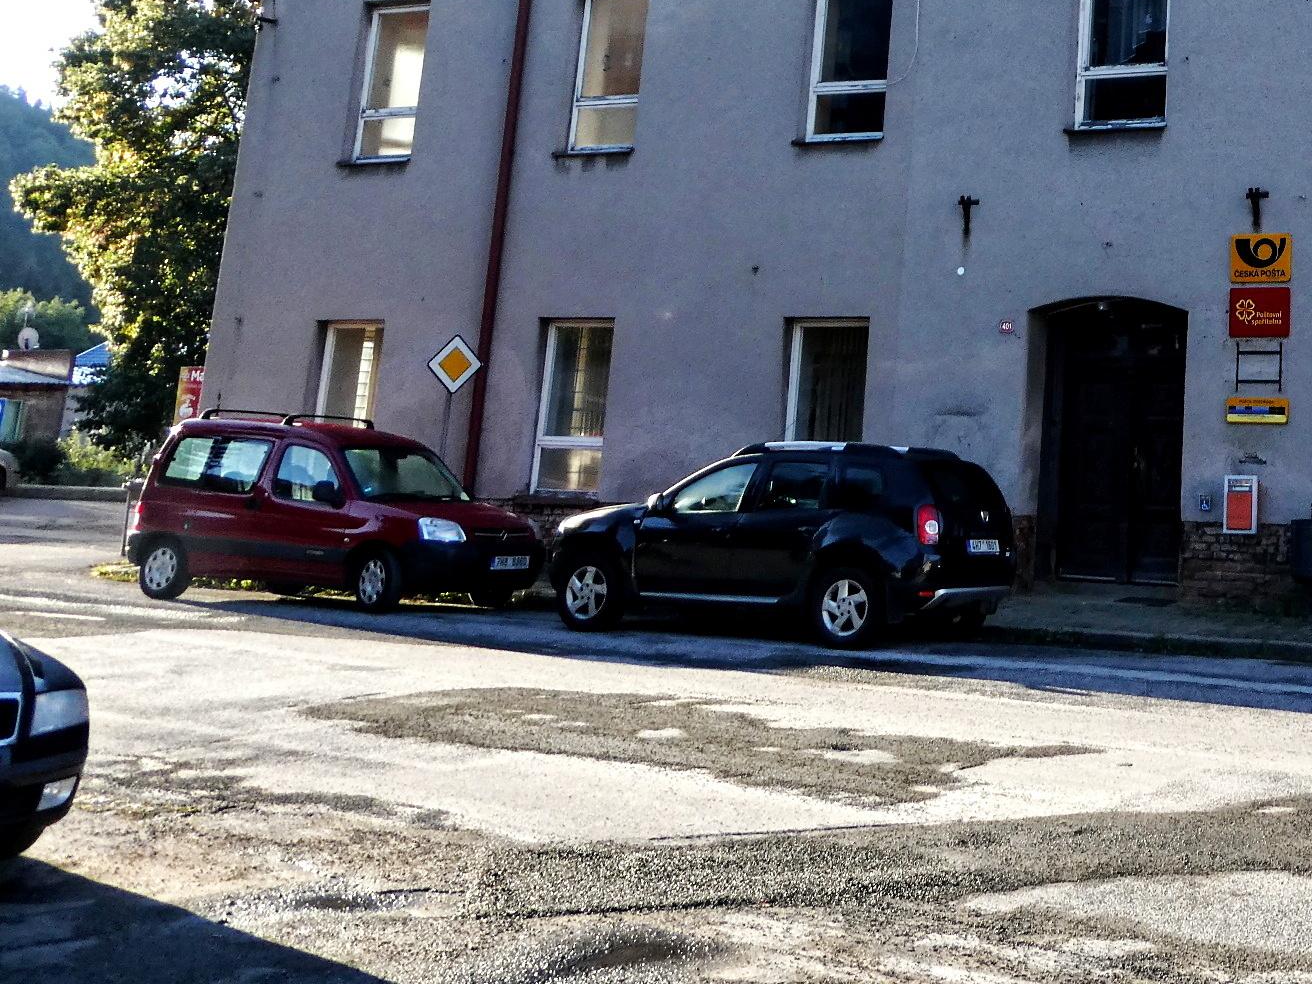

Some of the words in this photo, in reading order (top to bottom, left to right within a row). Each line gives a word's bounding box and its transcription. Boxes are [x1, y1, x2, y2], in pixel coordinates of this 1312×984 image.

[1234, 268, 1259, 277] ČESKÁ
[1260, 268, 1286, 277] POŠTA
[1256, 310, 1282, 318] Poštovní
[1251, 318, 1282, 326] spořitelna
